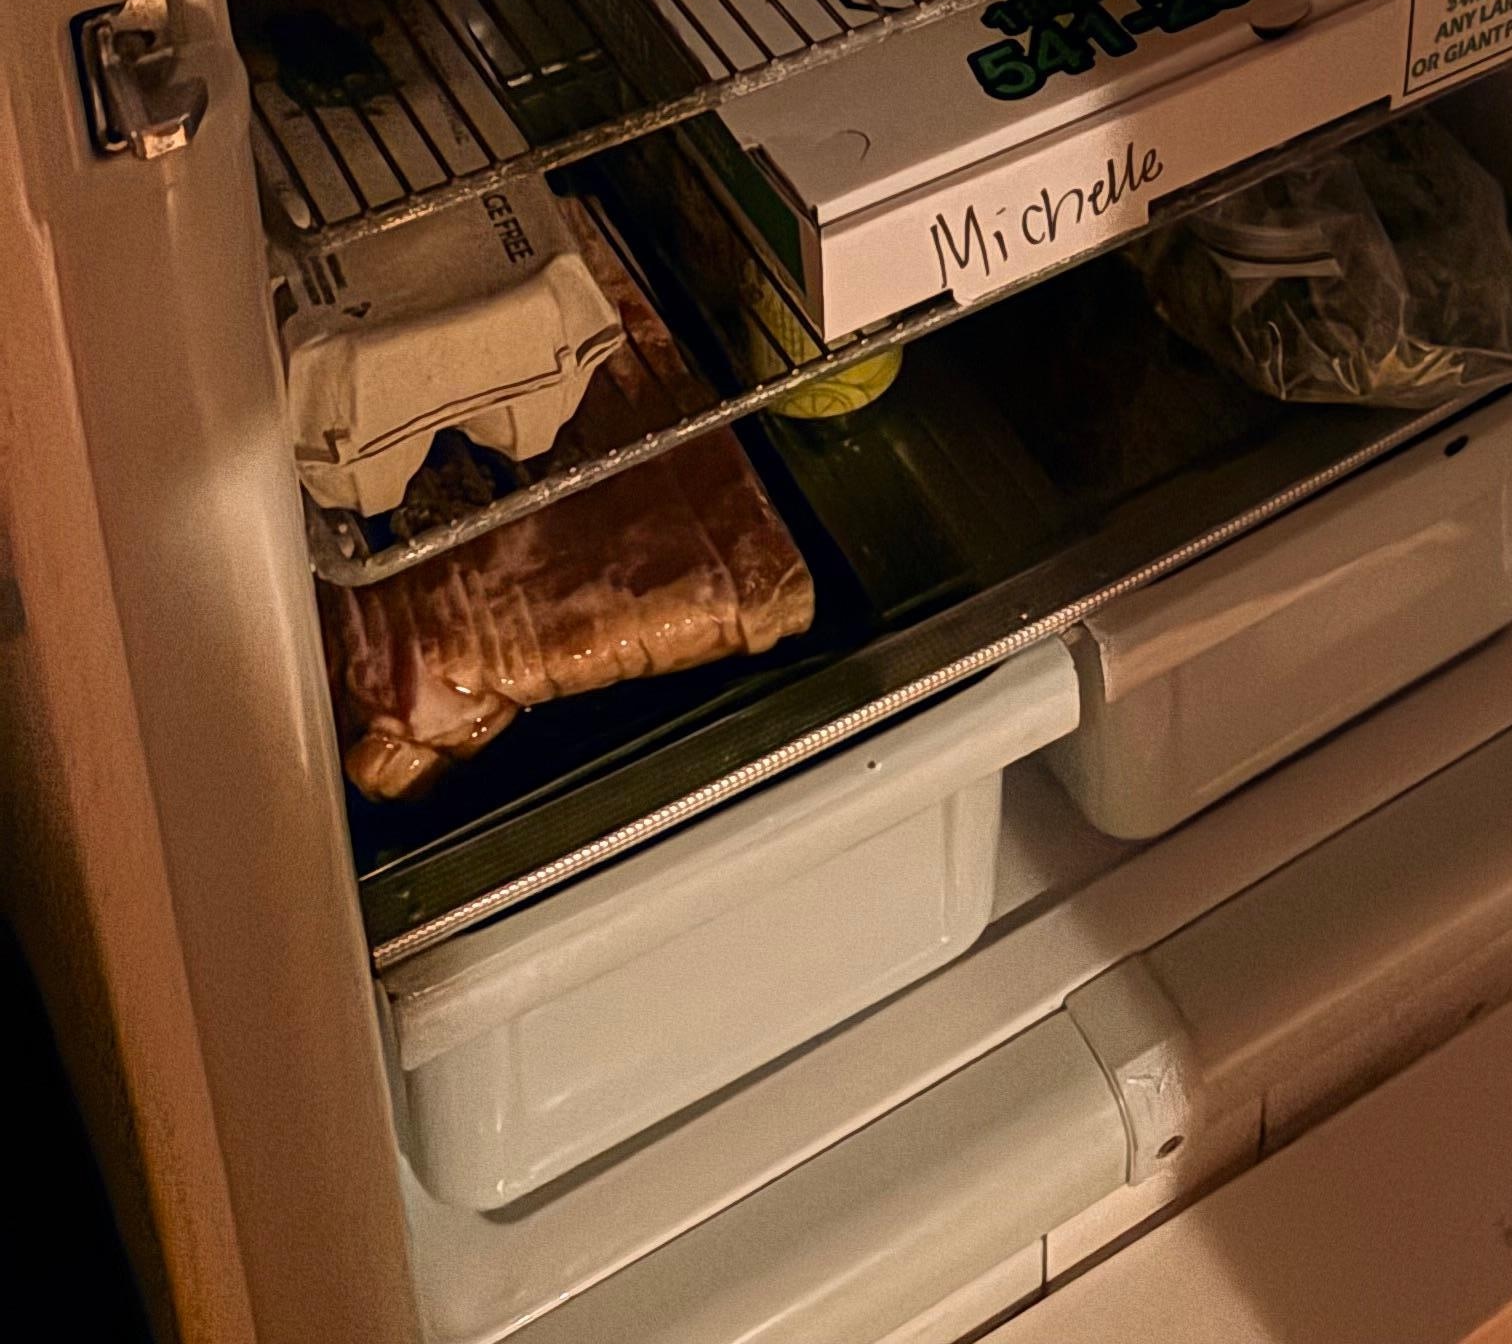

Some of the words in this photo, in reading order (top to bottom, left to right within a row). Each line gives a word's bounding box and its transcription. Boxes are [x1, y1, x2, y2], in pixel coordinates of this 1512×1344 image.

[1411, 52, 1439, 78] OR
[1444, 23, 1505, 64] GIANT
[1435, 8, 1478, 43] ANY
[493, 216, 536, 264] FREE
[929, 141, 1164, 289] Michelle
